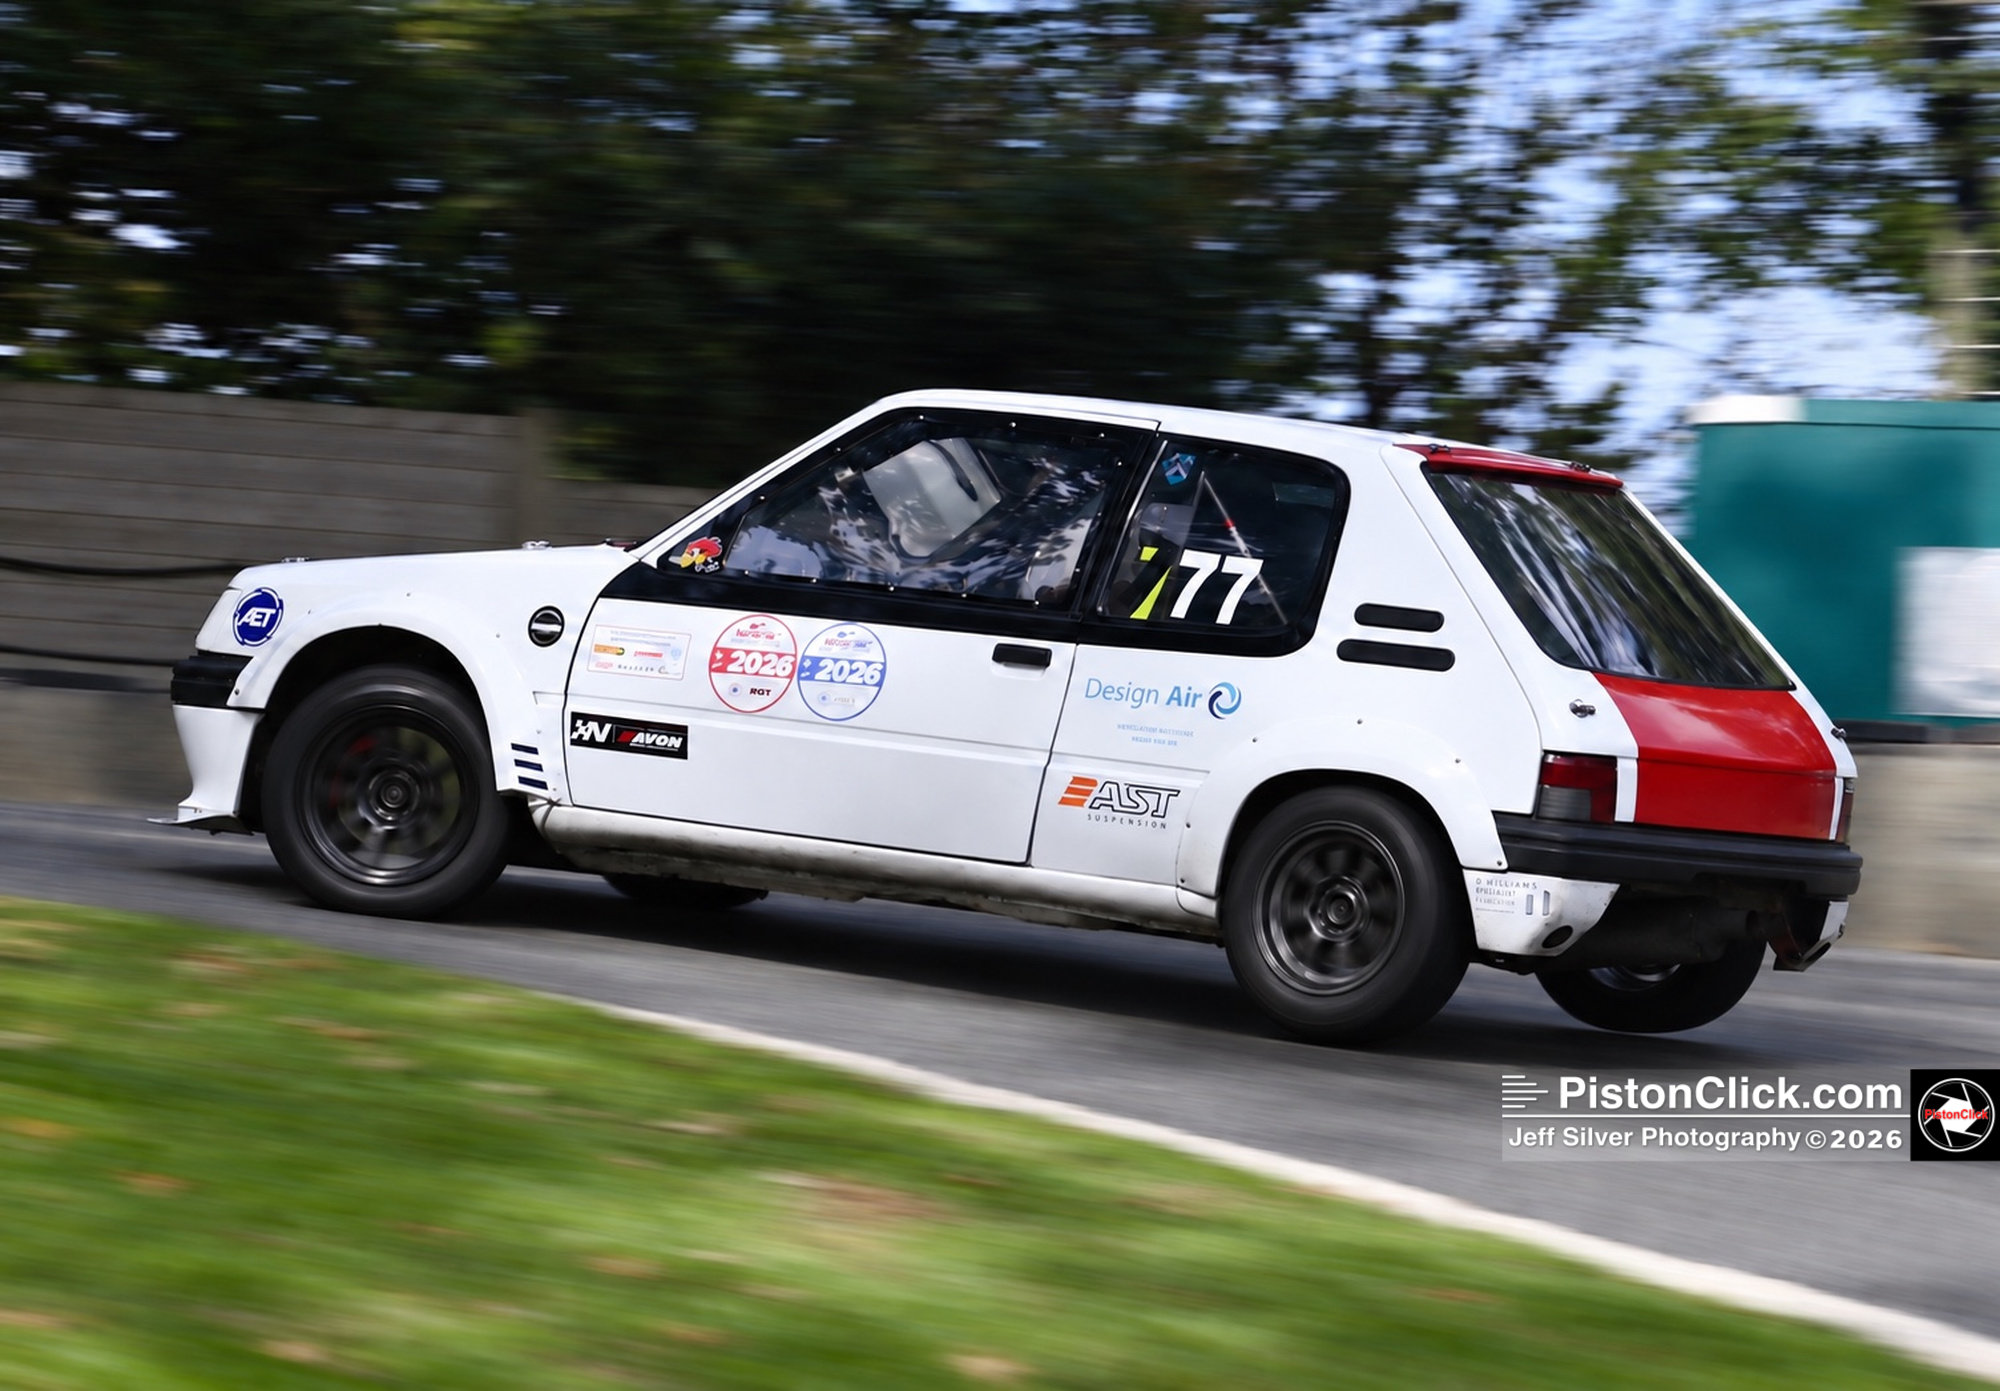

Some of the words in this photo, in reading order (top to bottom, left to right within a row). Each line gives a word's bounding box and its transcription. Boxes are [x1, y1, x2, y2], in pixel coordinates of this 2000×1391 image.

[726, 649, 796, 678] 2026
[813, 657, 884, 686] 2026
[749, 686, 772, 698] RGT
[1085, 677, 1160, 710] Design
[1165, 685, 1204, 709] Air
[631, 732, 683, 749] AVON
[1087, 813, 1167, 829] SUSPENSION
